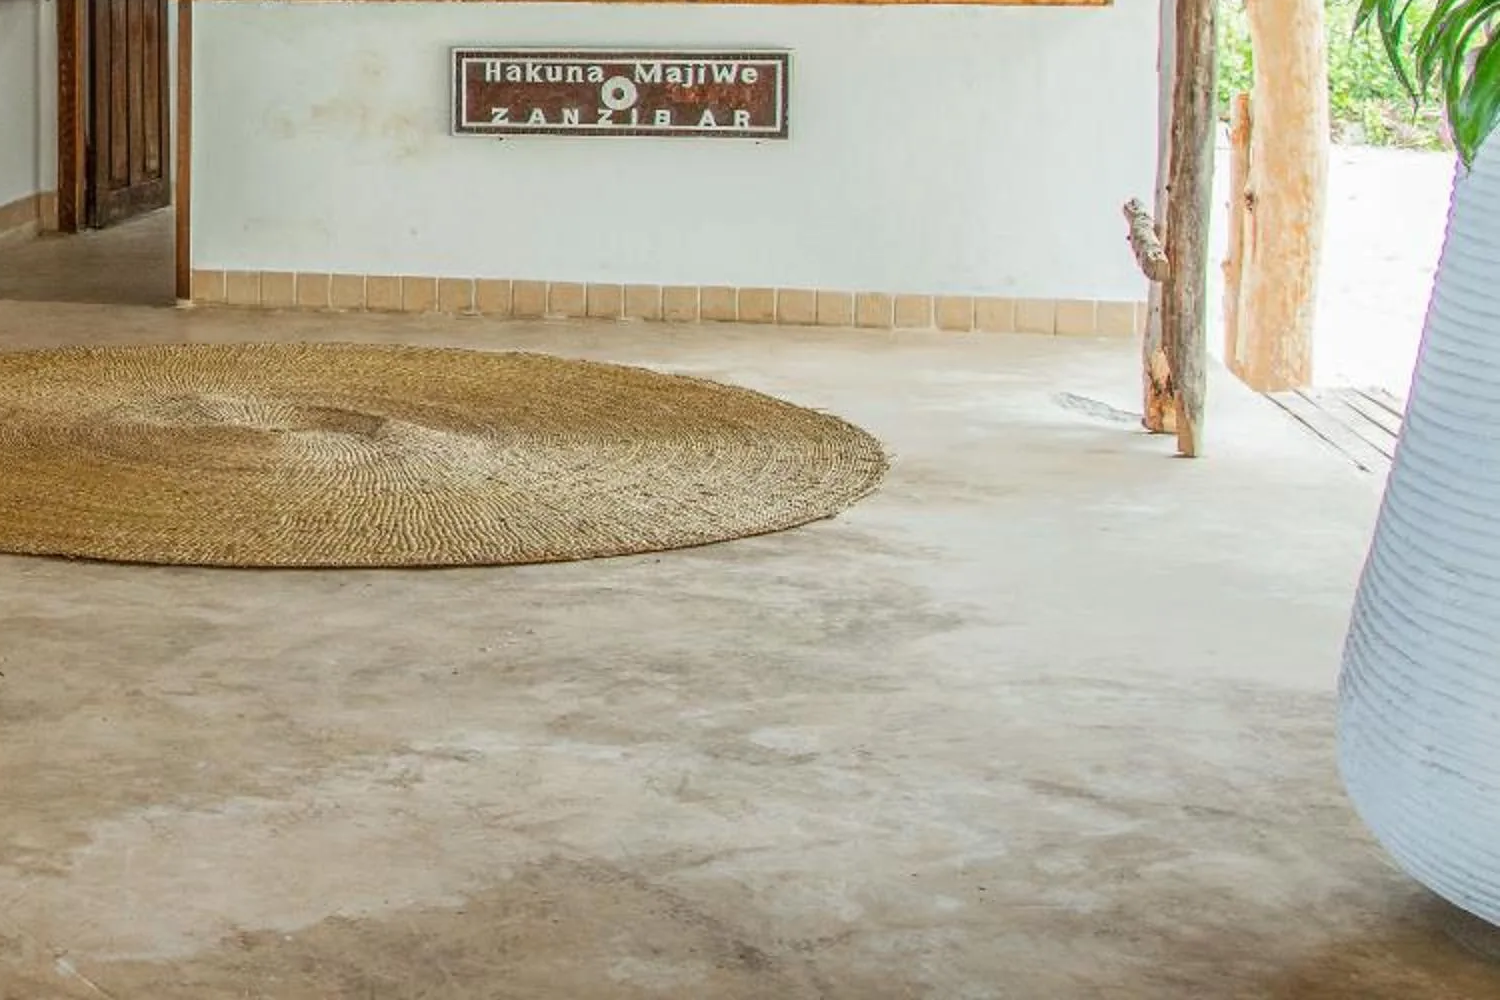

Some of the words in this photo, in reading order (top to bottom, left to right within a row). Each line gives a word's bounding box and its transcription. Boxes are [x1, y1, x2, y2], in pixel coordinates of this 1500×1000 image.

[484, 61, 604, 84] Hakuna
[633, 62, 759, 88] MajiWe
[490, 107, 752, 129] ZANZIBAR
